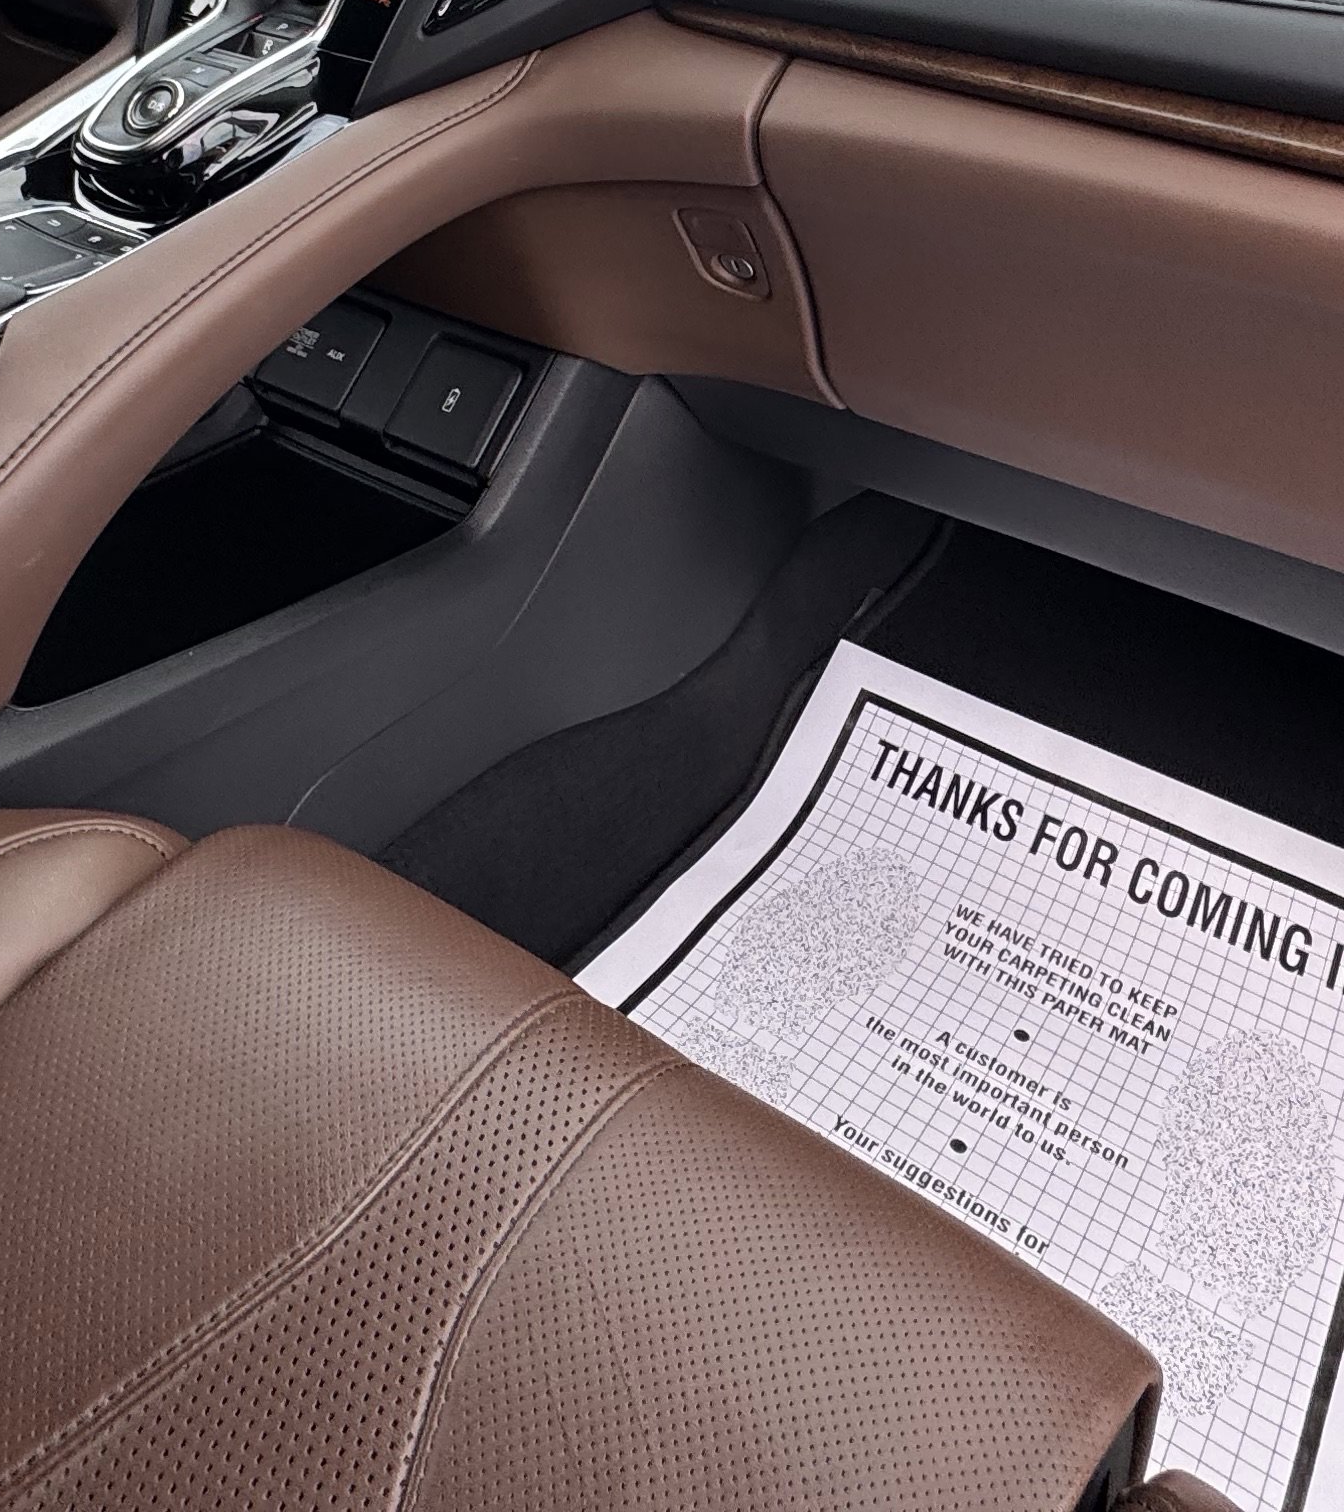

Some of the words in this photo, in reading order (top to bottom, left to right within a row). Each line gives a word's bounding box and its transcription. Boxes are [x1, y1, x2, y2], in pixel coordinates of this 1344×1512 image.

[265, 39, 274, 51] R
[325, 348, 346, 362] AUX
[869, 738, 1025, 843] THANKS
[1028, 813, 1119, 888] FOR
[1127, 856, 1314, 977] COMING
[943, 942, 992, 977] WITH
[994, 967, 1037, 1000] THIS
[1040, 991, 1105, 1033] PAPER
[1108, 1024, 1154, 1056] MAT
[944, 920, 995, 956] YOUR
[997, 947, 1103, 1009] CARPETING
[1107, 1000, 1172, 1043] CLEAN
[955, 903, 986, 928] WE
[986, 918, 1038, 952] HAVE
[1039, 942, 1094, 980] TRIED
[1099, 970, 1124, 995] TO
[1127, 986, 1179, 1019] KEEP
[864, 1015, 897, 1042] the
[899, 1036, 950, 1071] most
[952, 1062, 1053, 1129] important
[1053, 1120, 1131, 1170] person
[890, 1054, 912, 1076] in
[914, 1067, 948, 1096] the
[952, 1089, 1012, 1131] world
[1014, 1121, 1036, 1145] to
[1039, 1140, 1072, 1167] us.
[935, 1030, 952, 1047] A
[954, 1040, 1049, 1099] customer
[1051, 1089, 1073, 1112] is
[831, 1113, 880, 1153] Your
[880, 1147, 1012, 1234] suggestions
[1015, 1224, 1050, 1256] for
